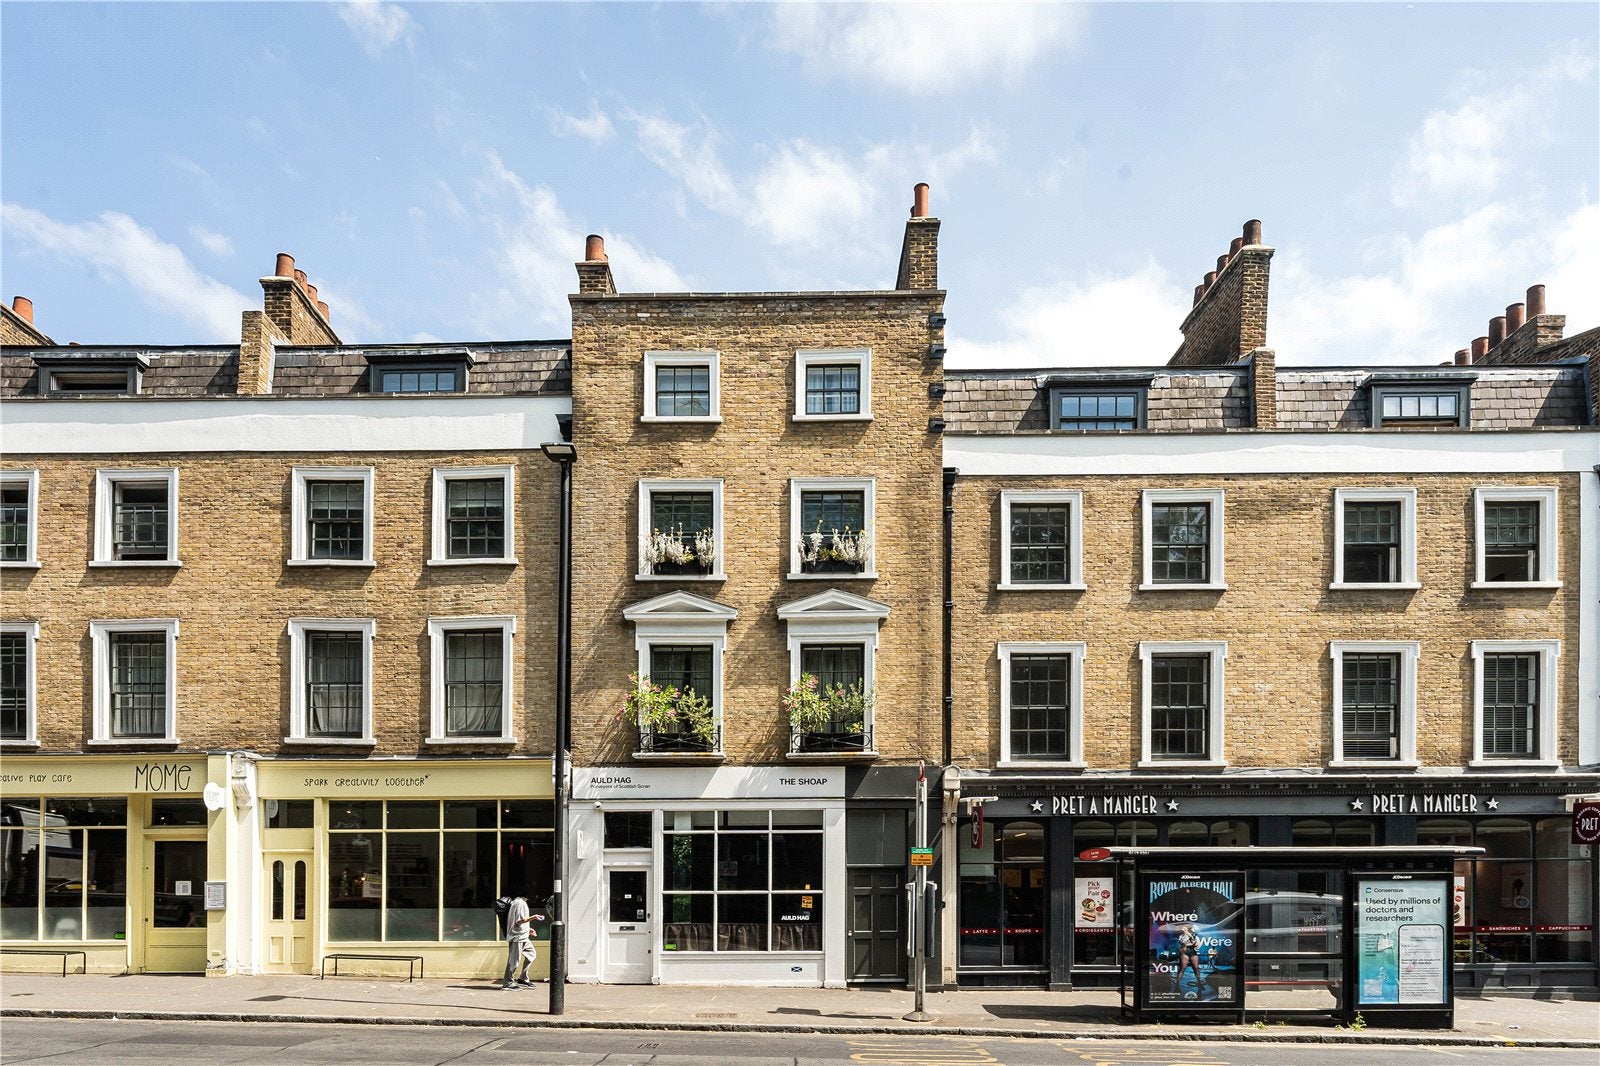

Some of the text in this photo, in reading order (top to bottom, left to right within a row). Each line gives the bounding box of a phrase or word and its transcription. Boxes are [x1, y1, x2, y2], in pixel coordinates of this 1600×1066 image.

[1052, 795, 1158, 815] PRET A MANGER
[1373, 794, 1478, 813] PRET A MANGER
[1581, 817, 1599, 830] PRET
[1149, 881, 1234, 904] ROYAL ALBERT HALL
[1365, 896, 1441, 906] Used by millions of
[1151, 911, 1198, 922] Where
[1365, 914, 1414, 922] researchers
[1198, 936, 1233, 947] Were
[1152, 962, 1178, 973] You
